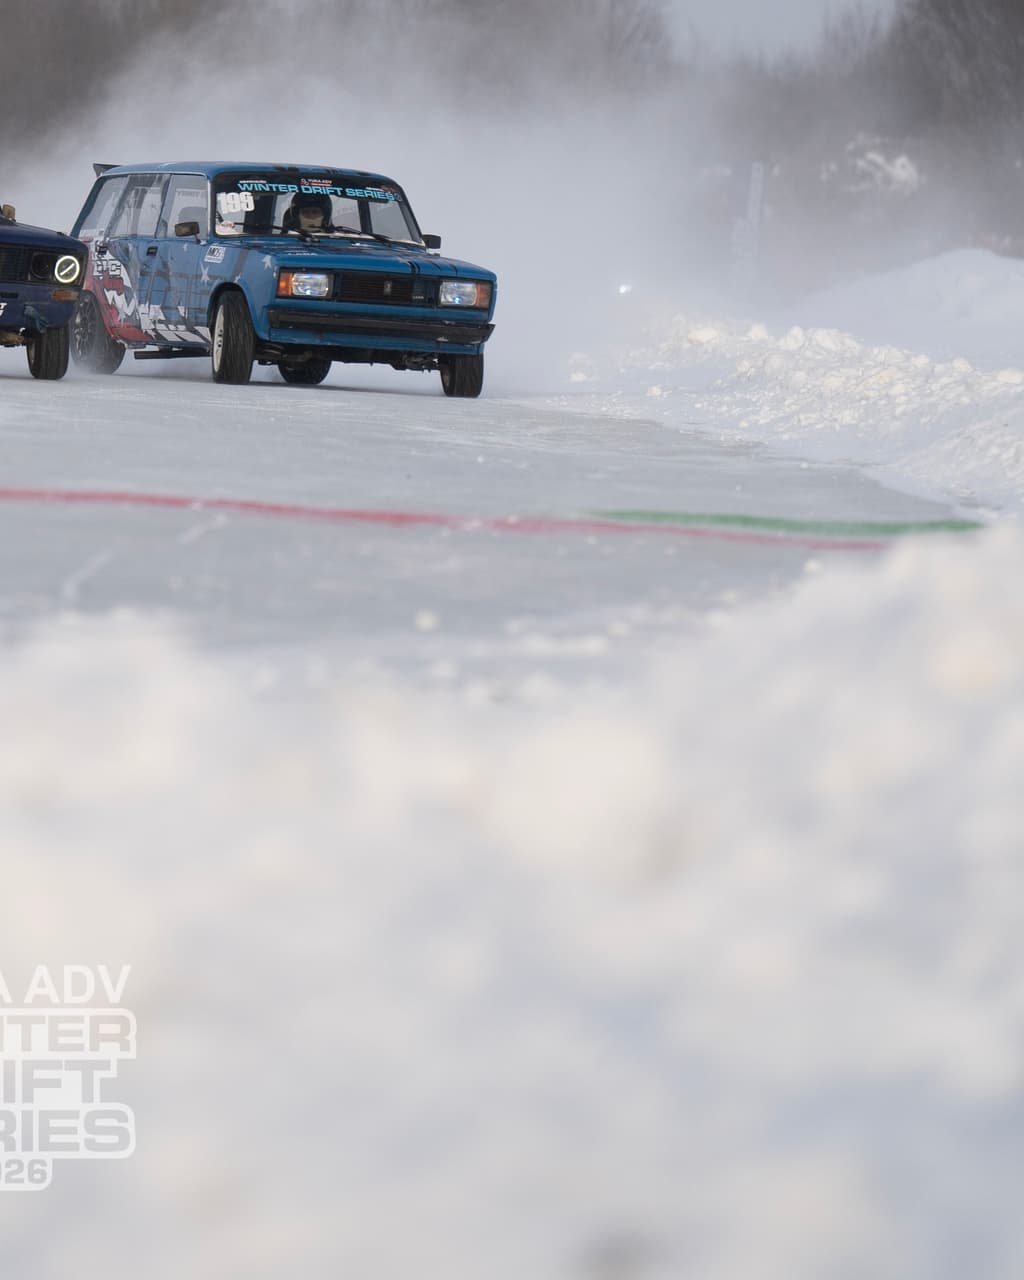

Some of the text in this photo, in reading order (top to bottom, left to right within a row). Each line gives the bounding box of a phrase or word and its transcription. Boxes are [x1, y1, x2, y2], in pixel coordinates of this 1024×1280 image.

[237, 183, 396, 201] WINTER DRIFT SERIES
